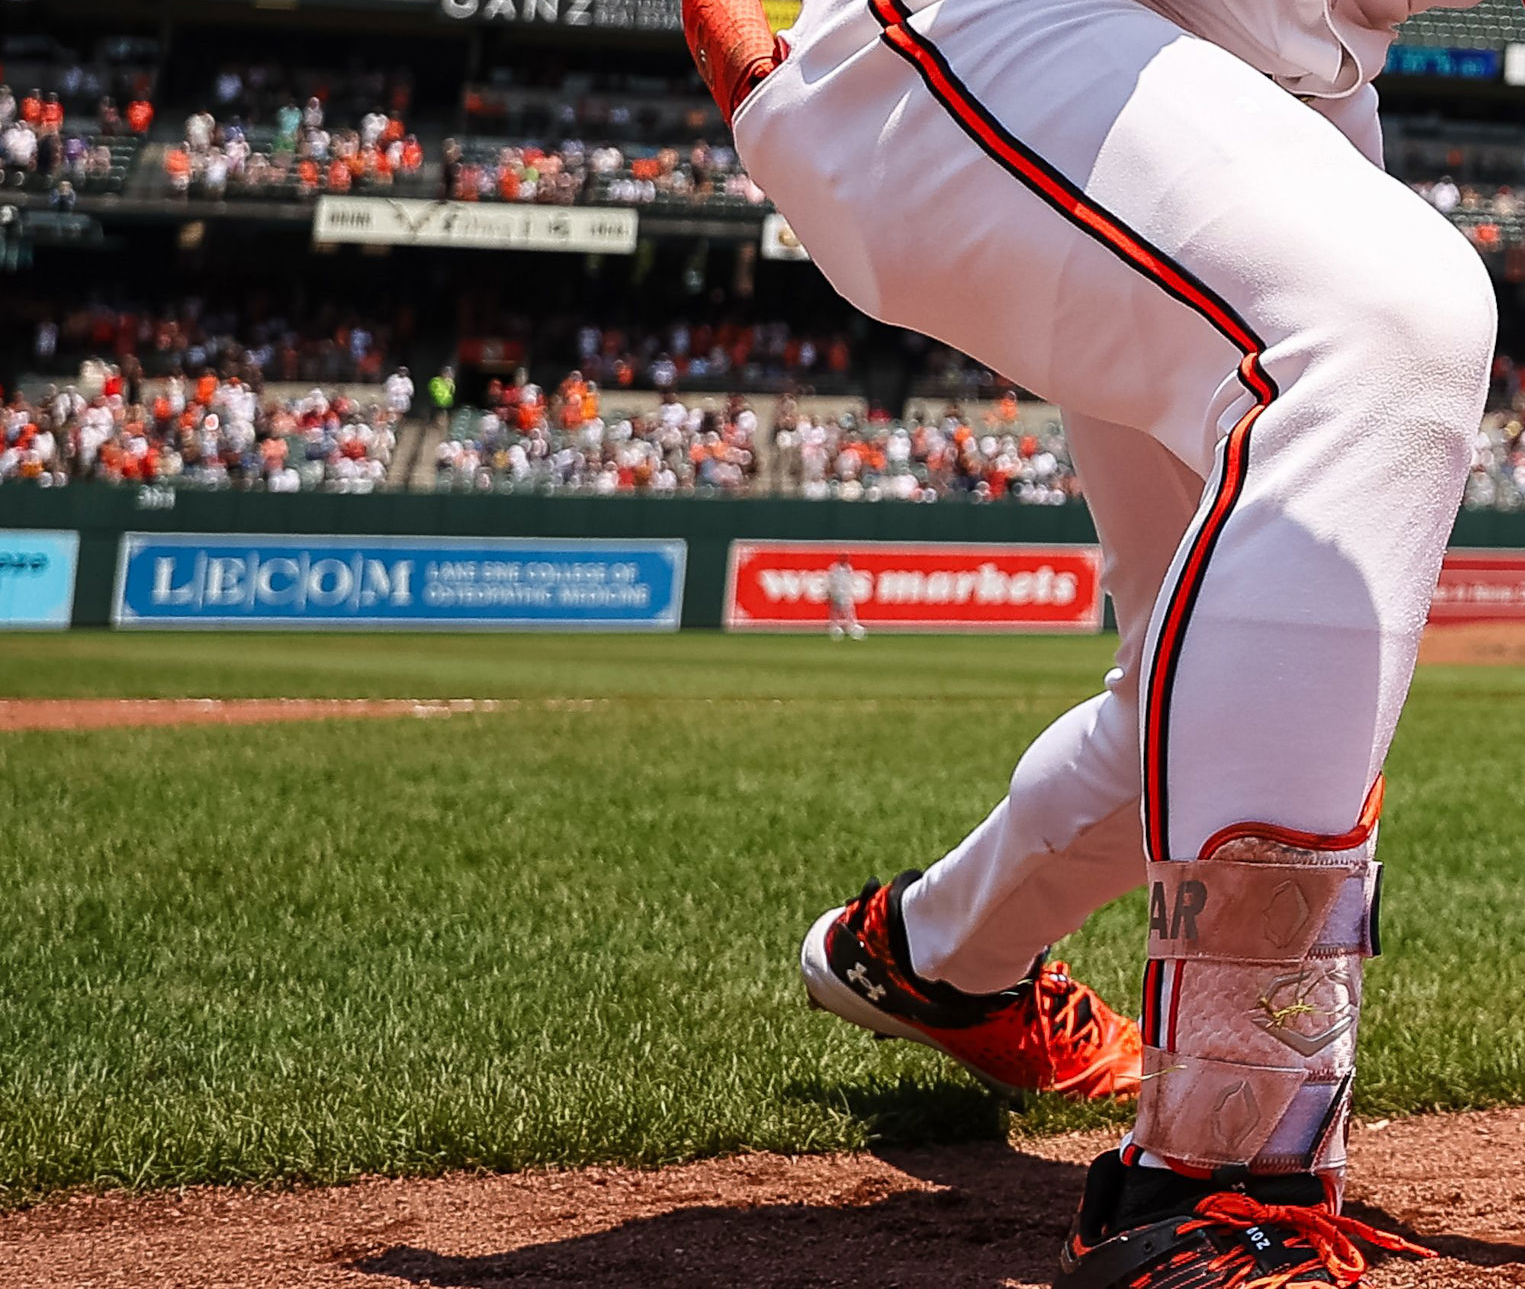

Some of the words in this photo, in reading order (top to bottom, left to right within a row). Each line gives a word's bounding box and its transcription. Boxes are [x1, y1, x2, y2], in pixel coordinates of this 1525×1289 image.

[151, 554, 412, 610] LECOM
[876, 563, 1077, 605] markets
[1149, 879, 1208, 941] AR
